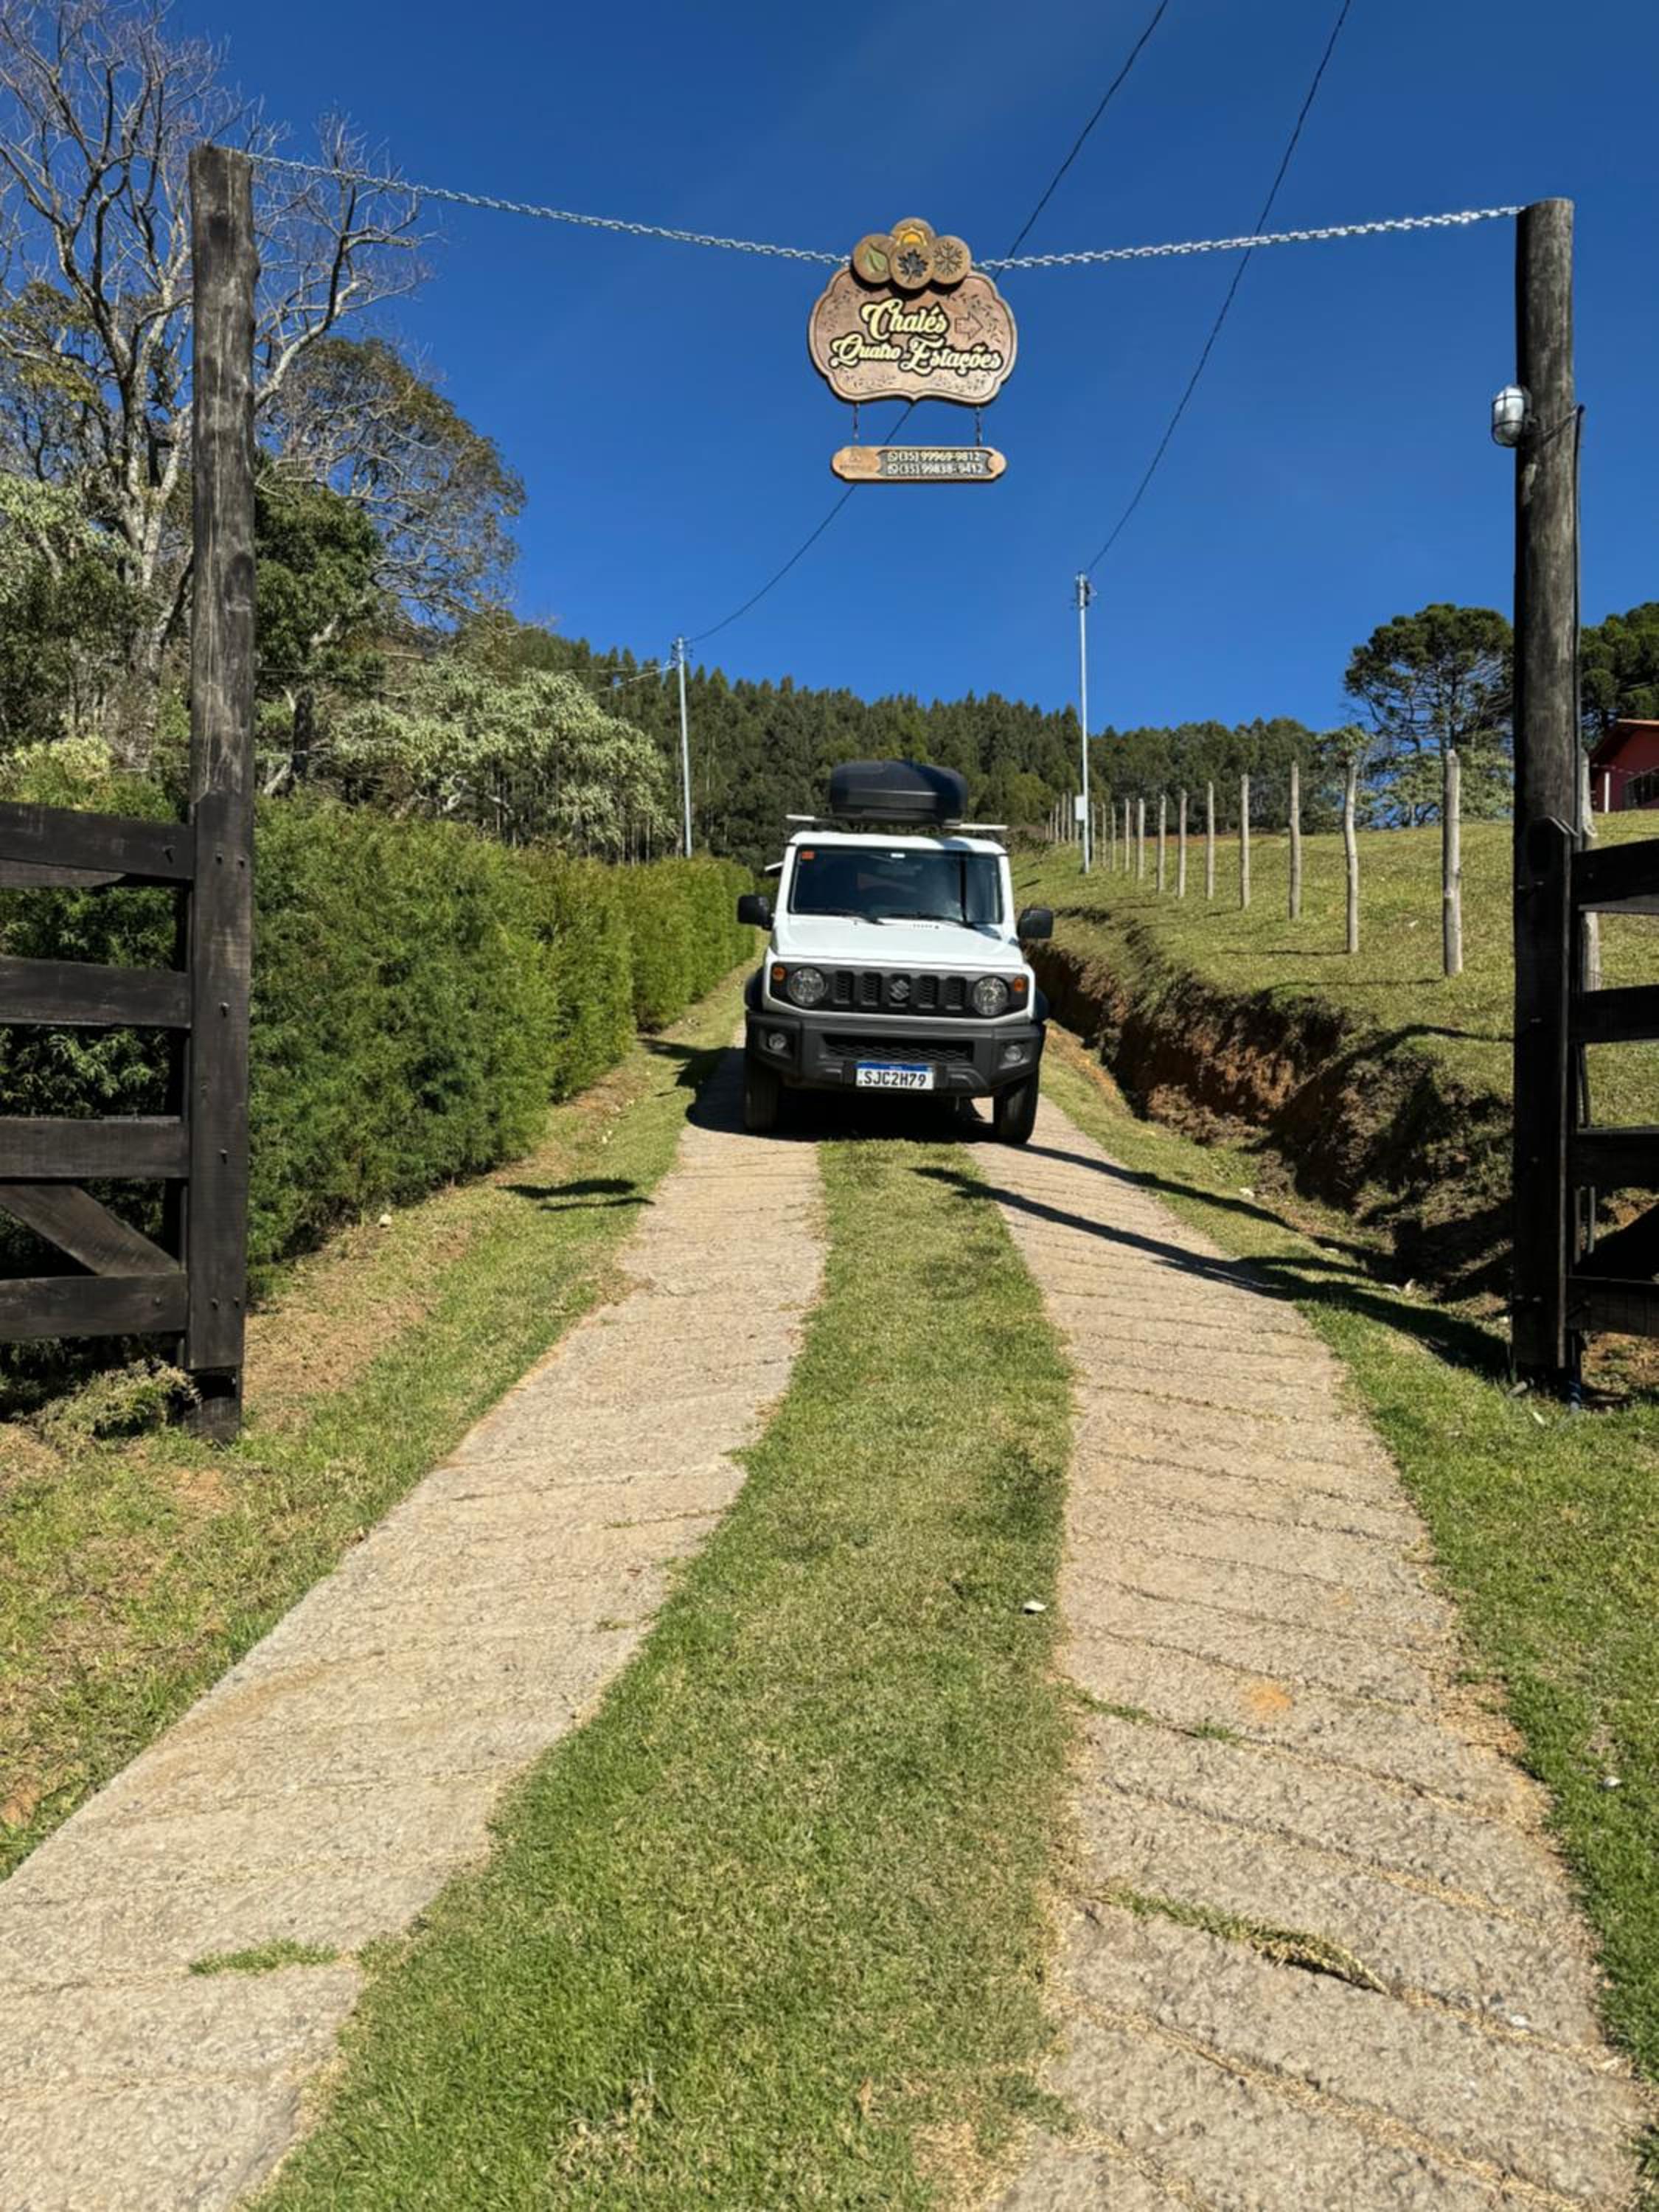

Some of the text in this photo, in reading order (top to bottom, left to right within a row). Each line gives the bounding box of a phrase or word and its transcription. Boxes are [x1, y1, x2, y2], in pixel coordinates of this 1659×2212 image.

[860, 299, 948, 341] Chalés
[831, 335, 1002, 375] Quatro Estações
[899, 451, 919, 462] (35)
[863, 1071, 927, 1088] SJC2H79
